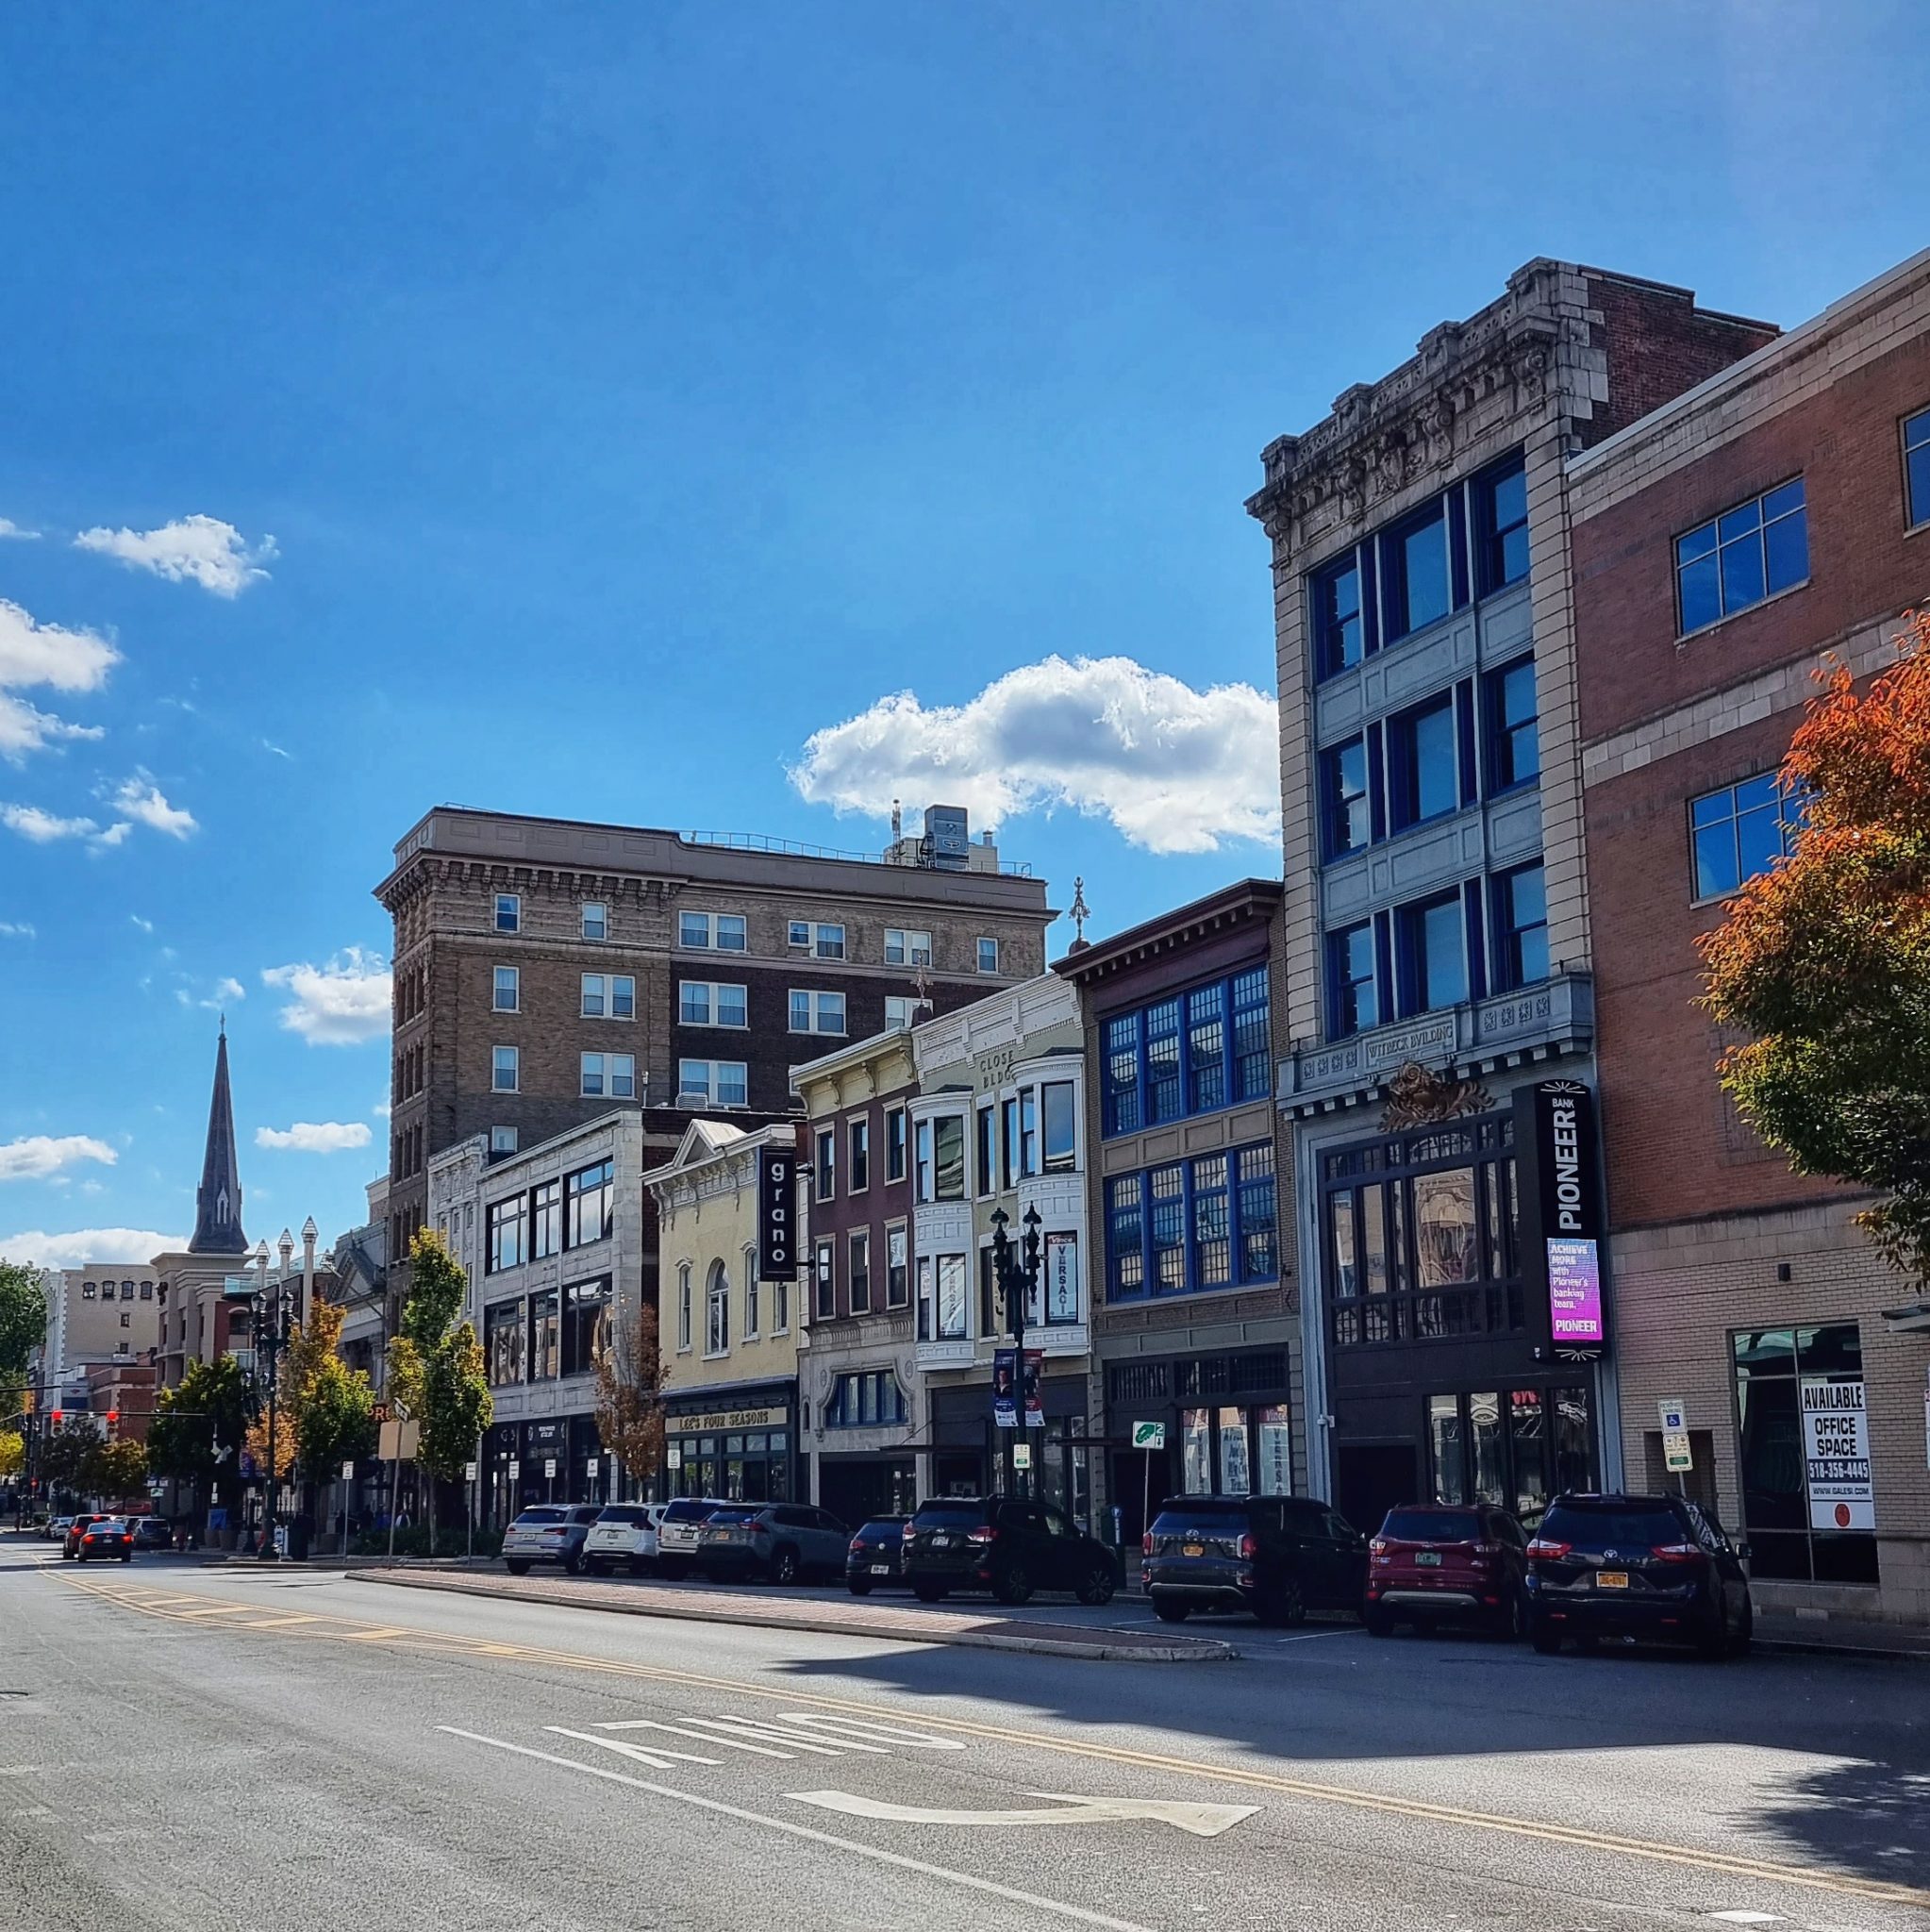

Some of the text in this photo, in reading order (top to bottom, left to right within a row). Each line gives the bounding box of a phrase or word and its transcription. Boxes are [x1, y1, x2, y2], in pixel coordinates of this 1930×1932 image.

[980, 1050, 1013, 1073] CLOSE
[983, 1068, 1011, 1089] BLDG
[1552, 1097, 1575, 1108] BANK
[1553, 1109, 1582, 1230] PIONEER
[771, 1162, 786, 1262] grano
[1551, 1244, 1588, 1255] ACHIEVE
[1552, 1255, 1577, 1265] MORE
[1553, 1266, 1570, 1275] with
[1057, 1245, 1068, 1314] VERSACI
[1553, 1276, 1589, 1287] Pioneer's
[1553, 1288, 1585, 1300] banking
[1556, 1319, 1597, 1332] PIONEER
[1805, 1386, 1863, 1409] AVAILABLE
[704, 1414, 725, 1428] FOUR
[729, 1410, 769, 1426] SEASONS
[1815, 1417, 1856, 1436] OFFICE
[1156, 1424, 1163, 1434] 2
[1817, 1439, 1857, 1457] SPACE
[1809, 1462, 1869, 1478] 518-356-4445
[1813, 1487, 1870, 1495] WWW.GALESI.COM
[541, 1712, 967, 1770] ONLY
